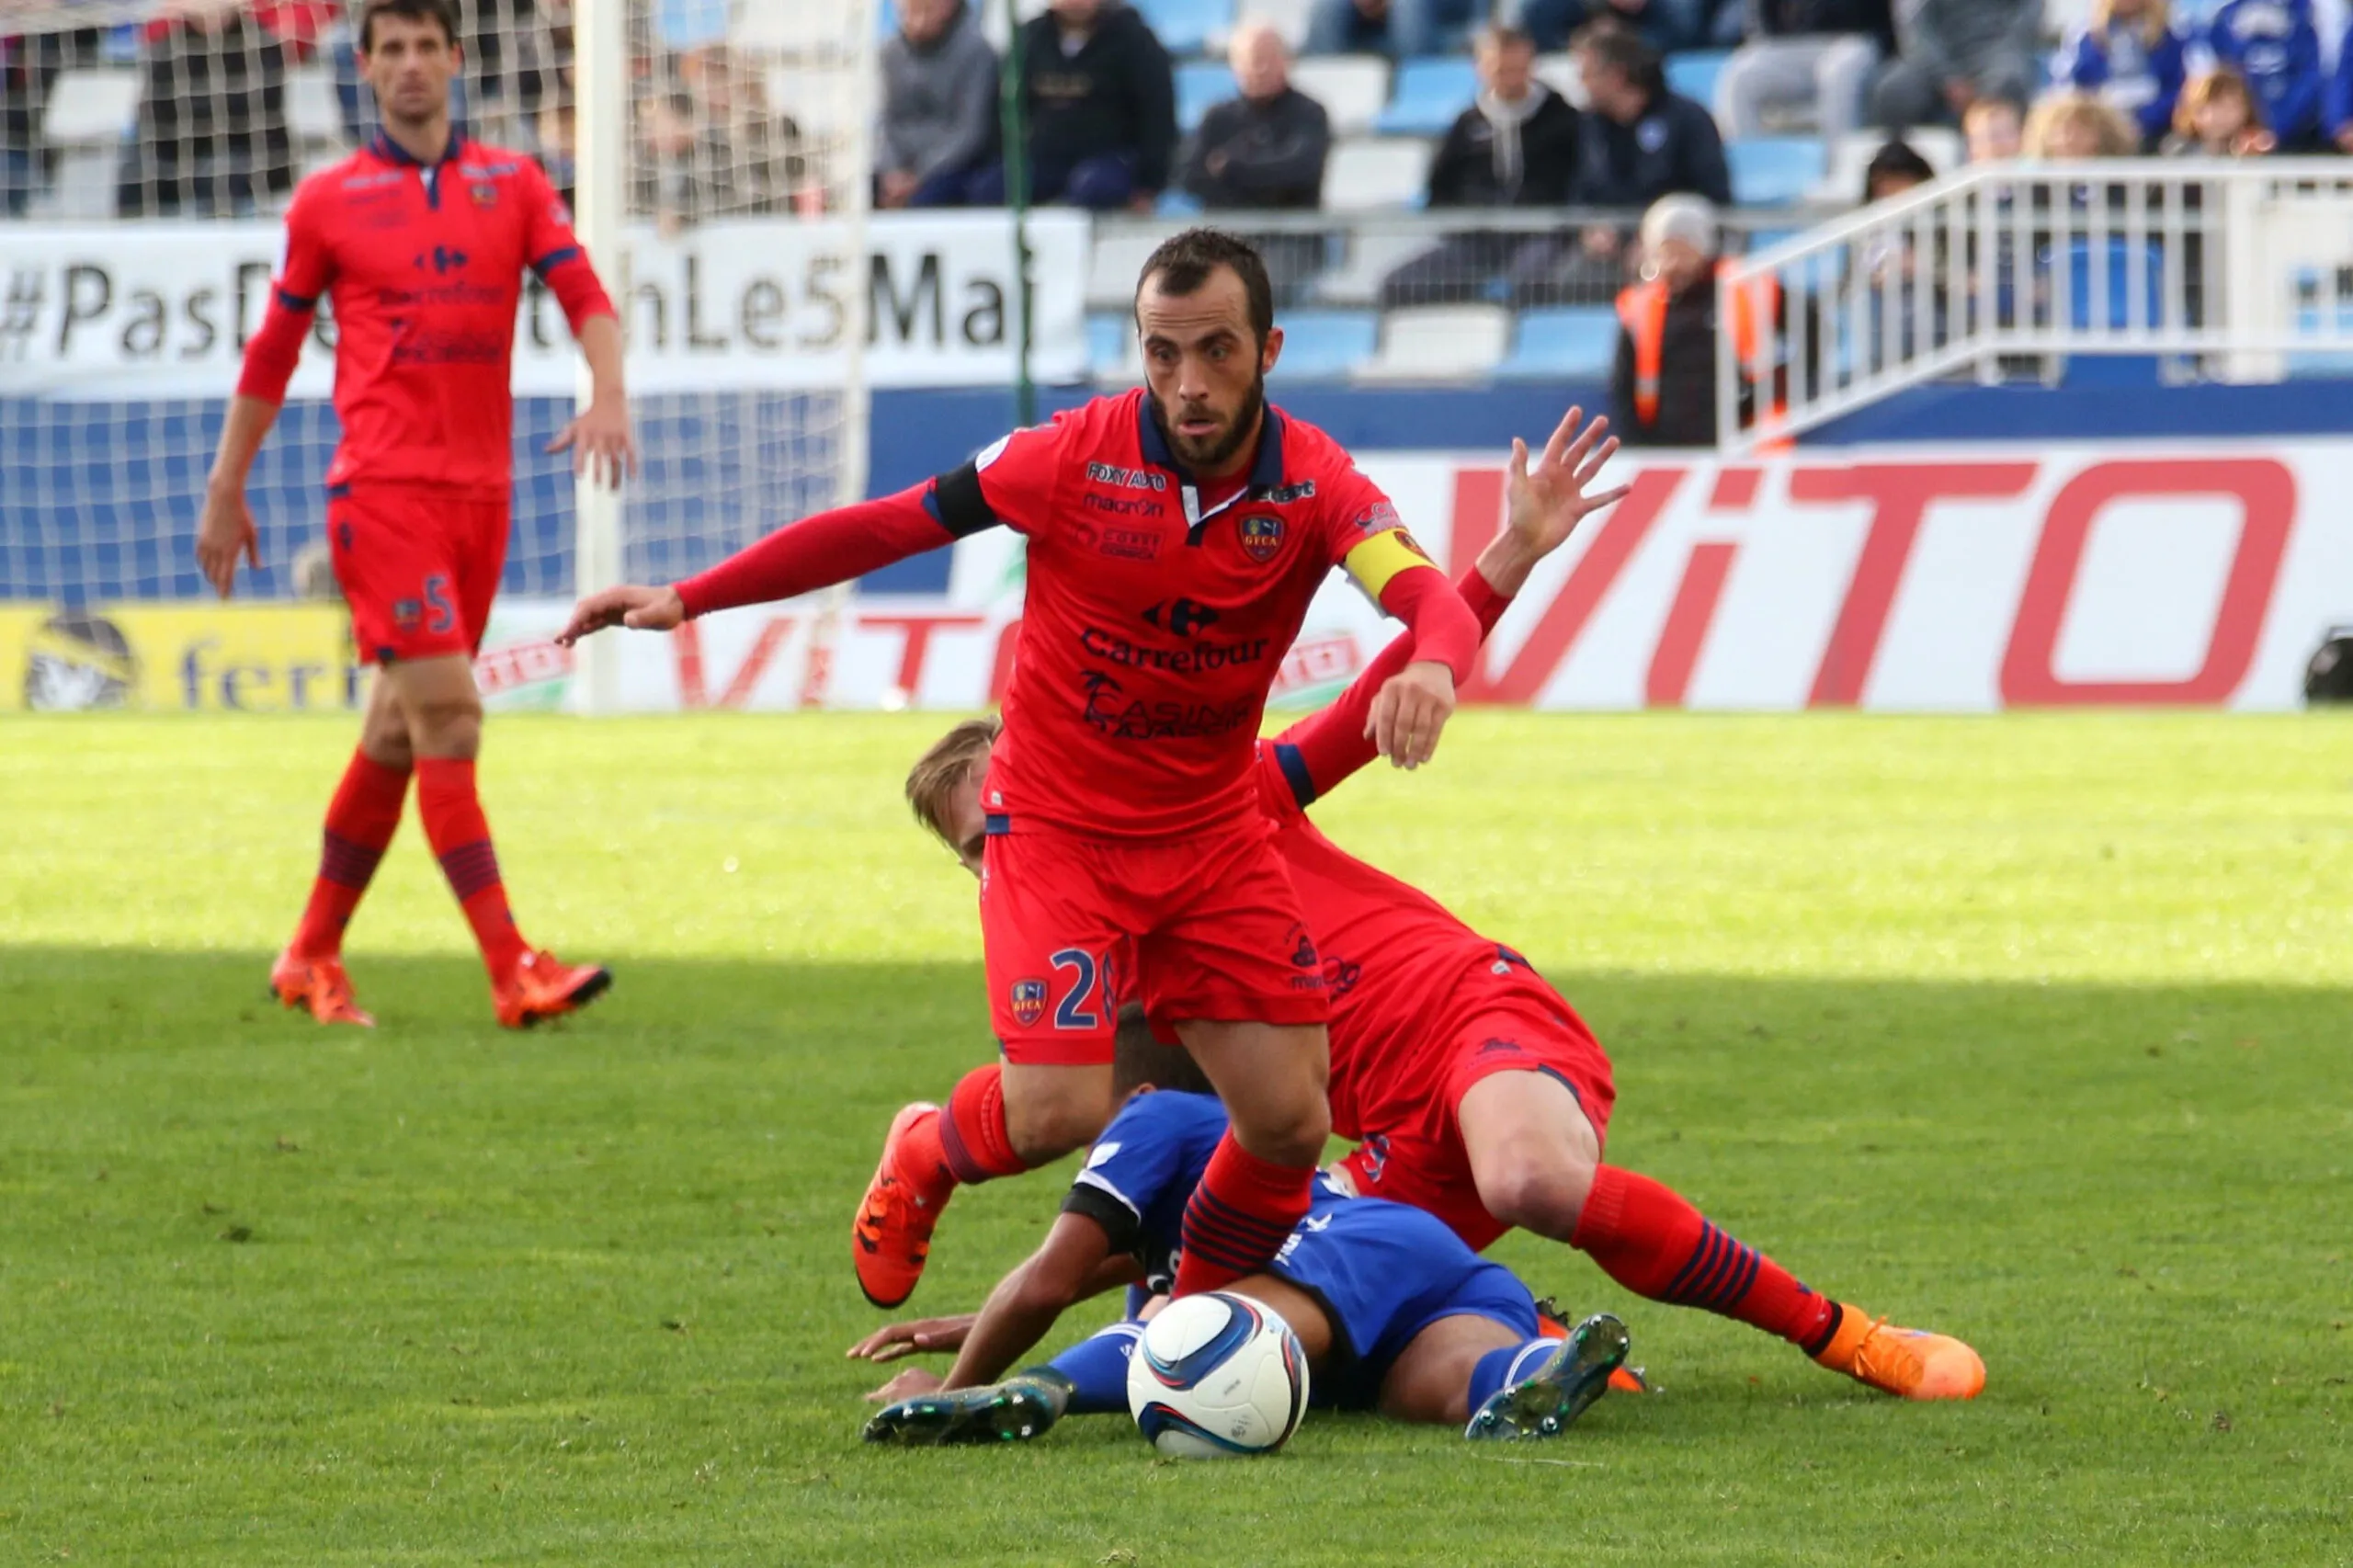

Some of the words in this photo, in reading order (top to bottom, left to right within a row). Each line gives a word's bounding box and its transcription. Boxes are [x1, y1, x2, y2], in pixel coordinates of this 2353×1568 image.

[1083, 493, 1165, 517] macron
[423, 572, 458, 634] 5
[1082, 627, 1270, 675] Carrefour
